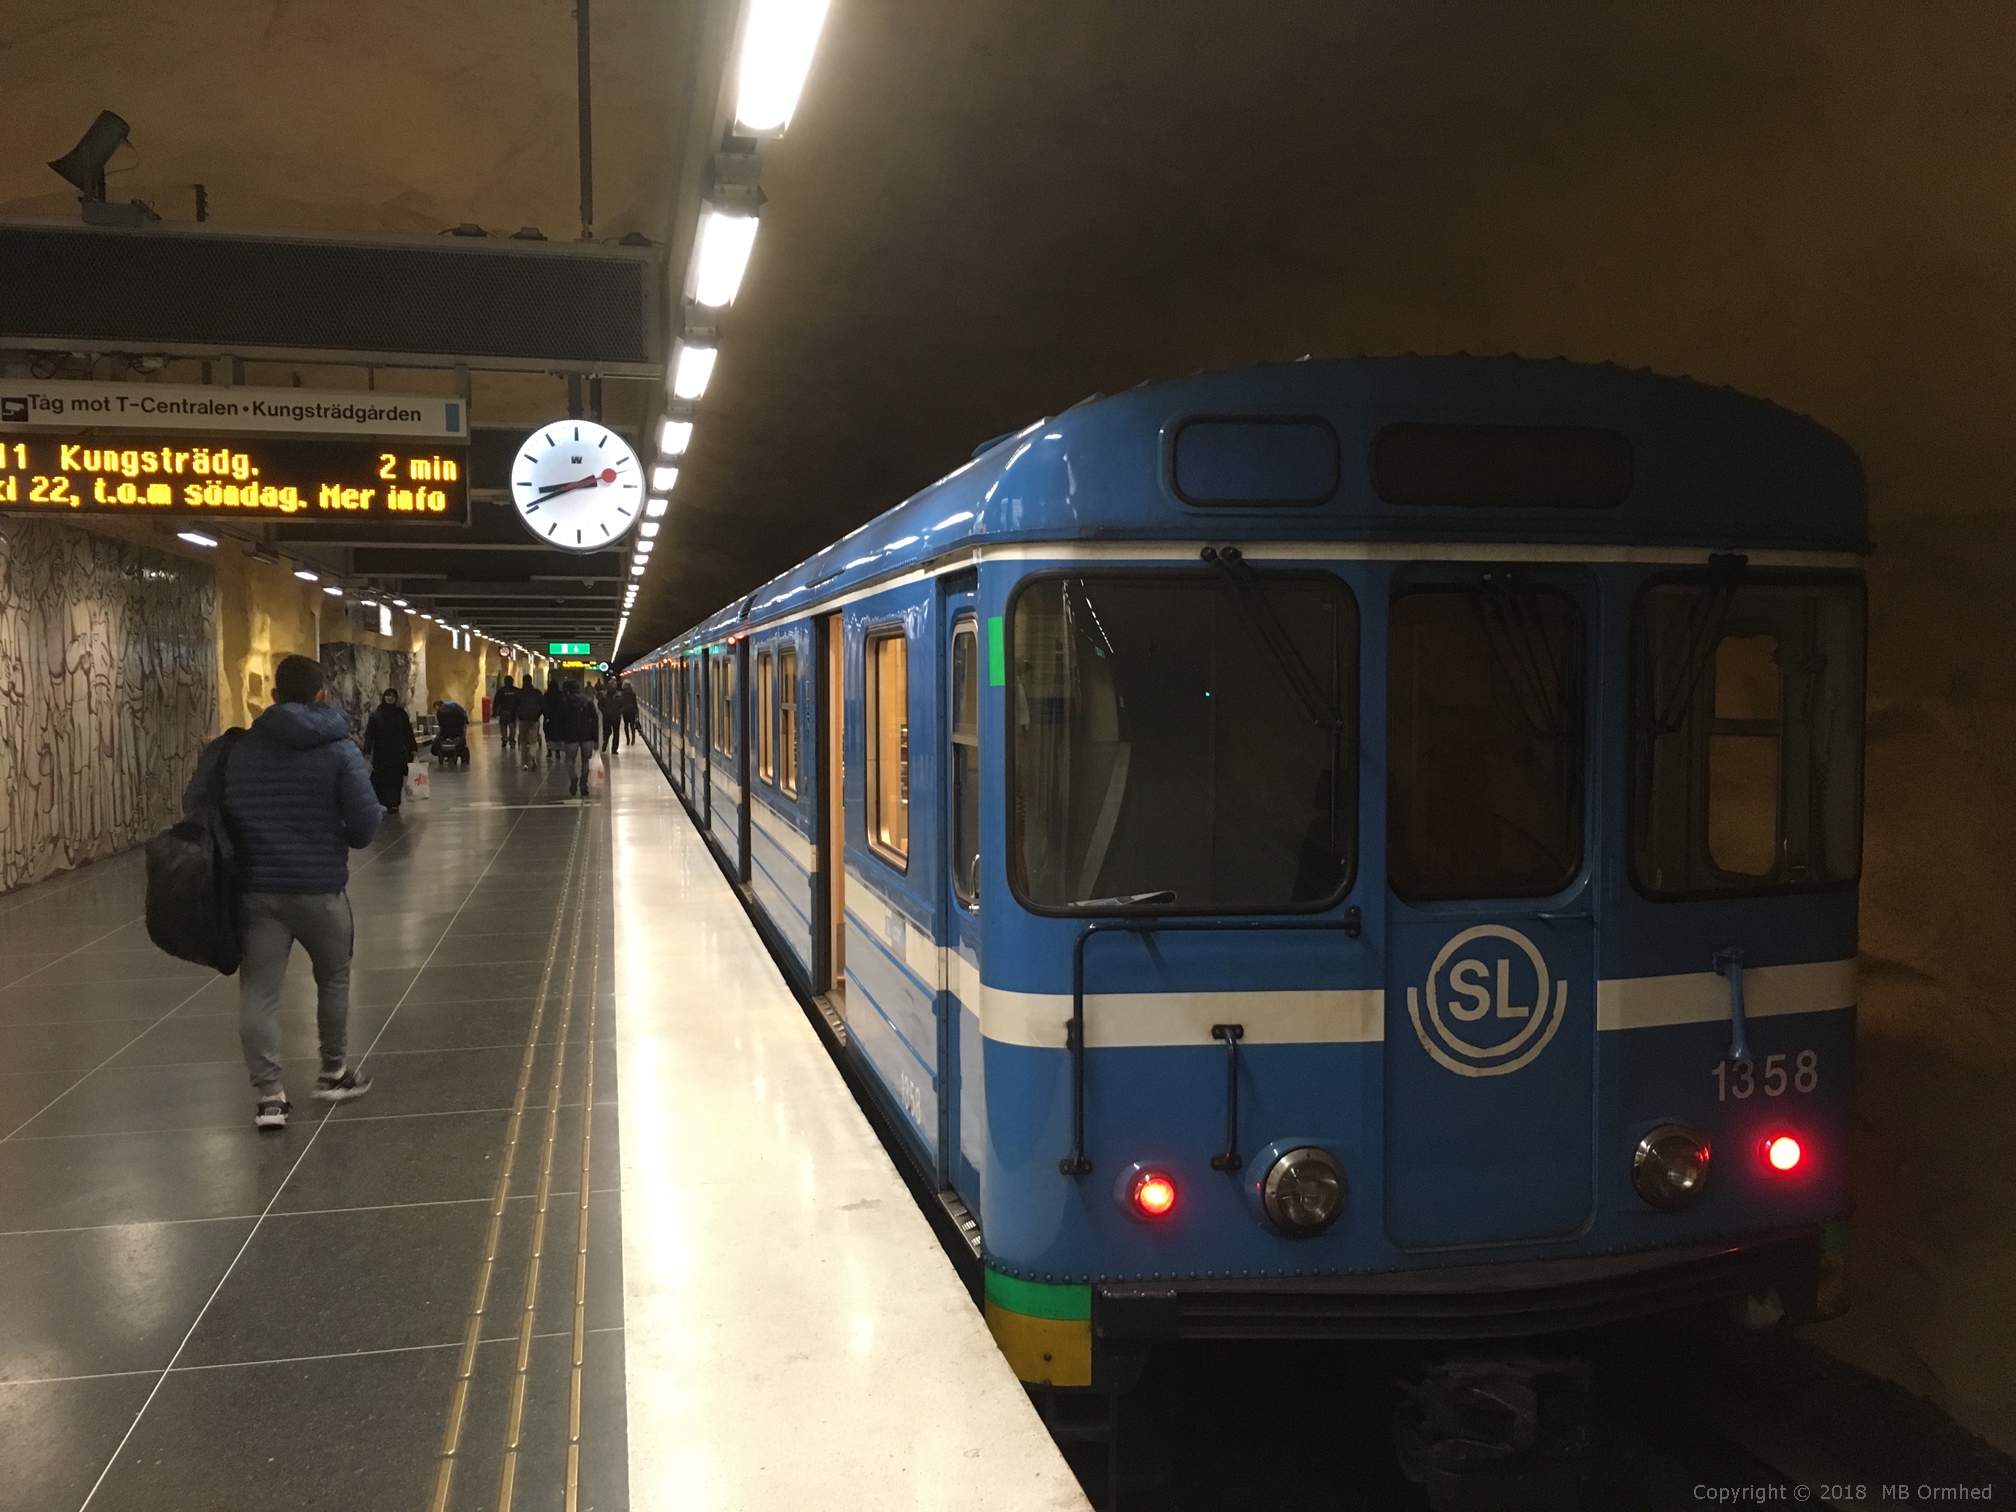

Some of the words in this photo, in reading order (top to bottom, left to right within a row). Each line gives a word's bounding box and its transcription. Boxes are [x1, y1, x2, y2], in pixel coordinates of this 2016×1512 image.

[28, 393, 64, 415] Tåg
[71, 396, 111, 412] mot
[60, 444, 259, 480] Kungsträdg.
[379, 453, 397, 480] 2
[409, 455, 458, 482] min
[29, 475, 80, 508] 22,
[183, 479, 308, 513] söndag.
[319, 483, 376, 510] Mer
[387, 485, 447, 512] info
[1448, 958, 1530, 1022] SL
[1710, 1048, 1819, 1102] 1358
